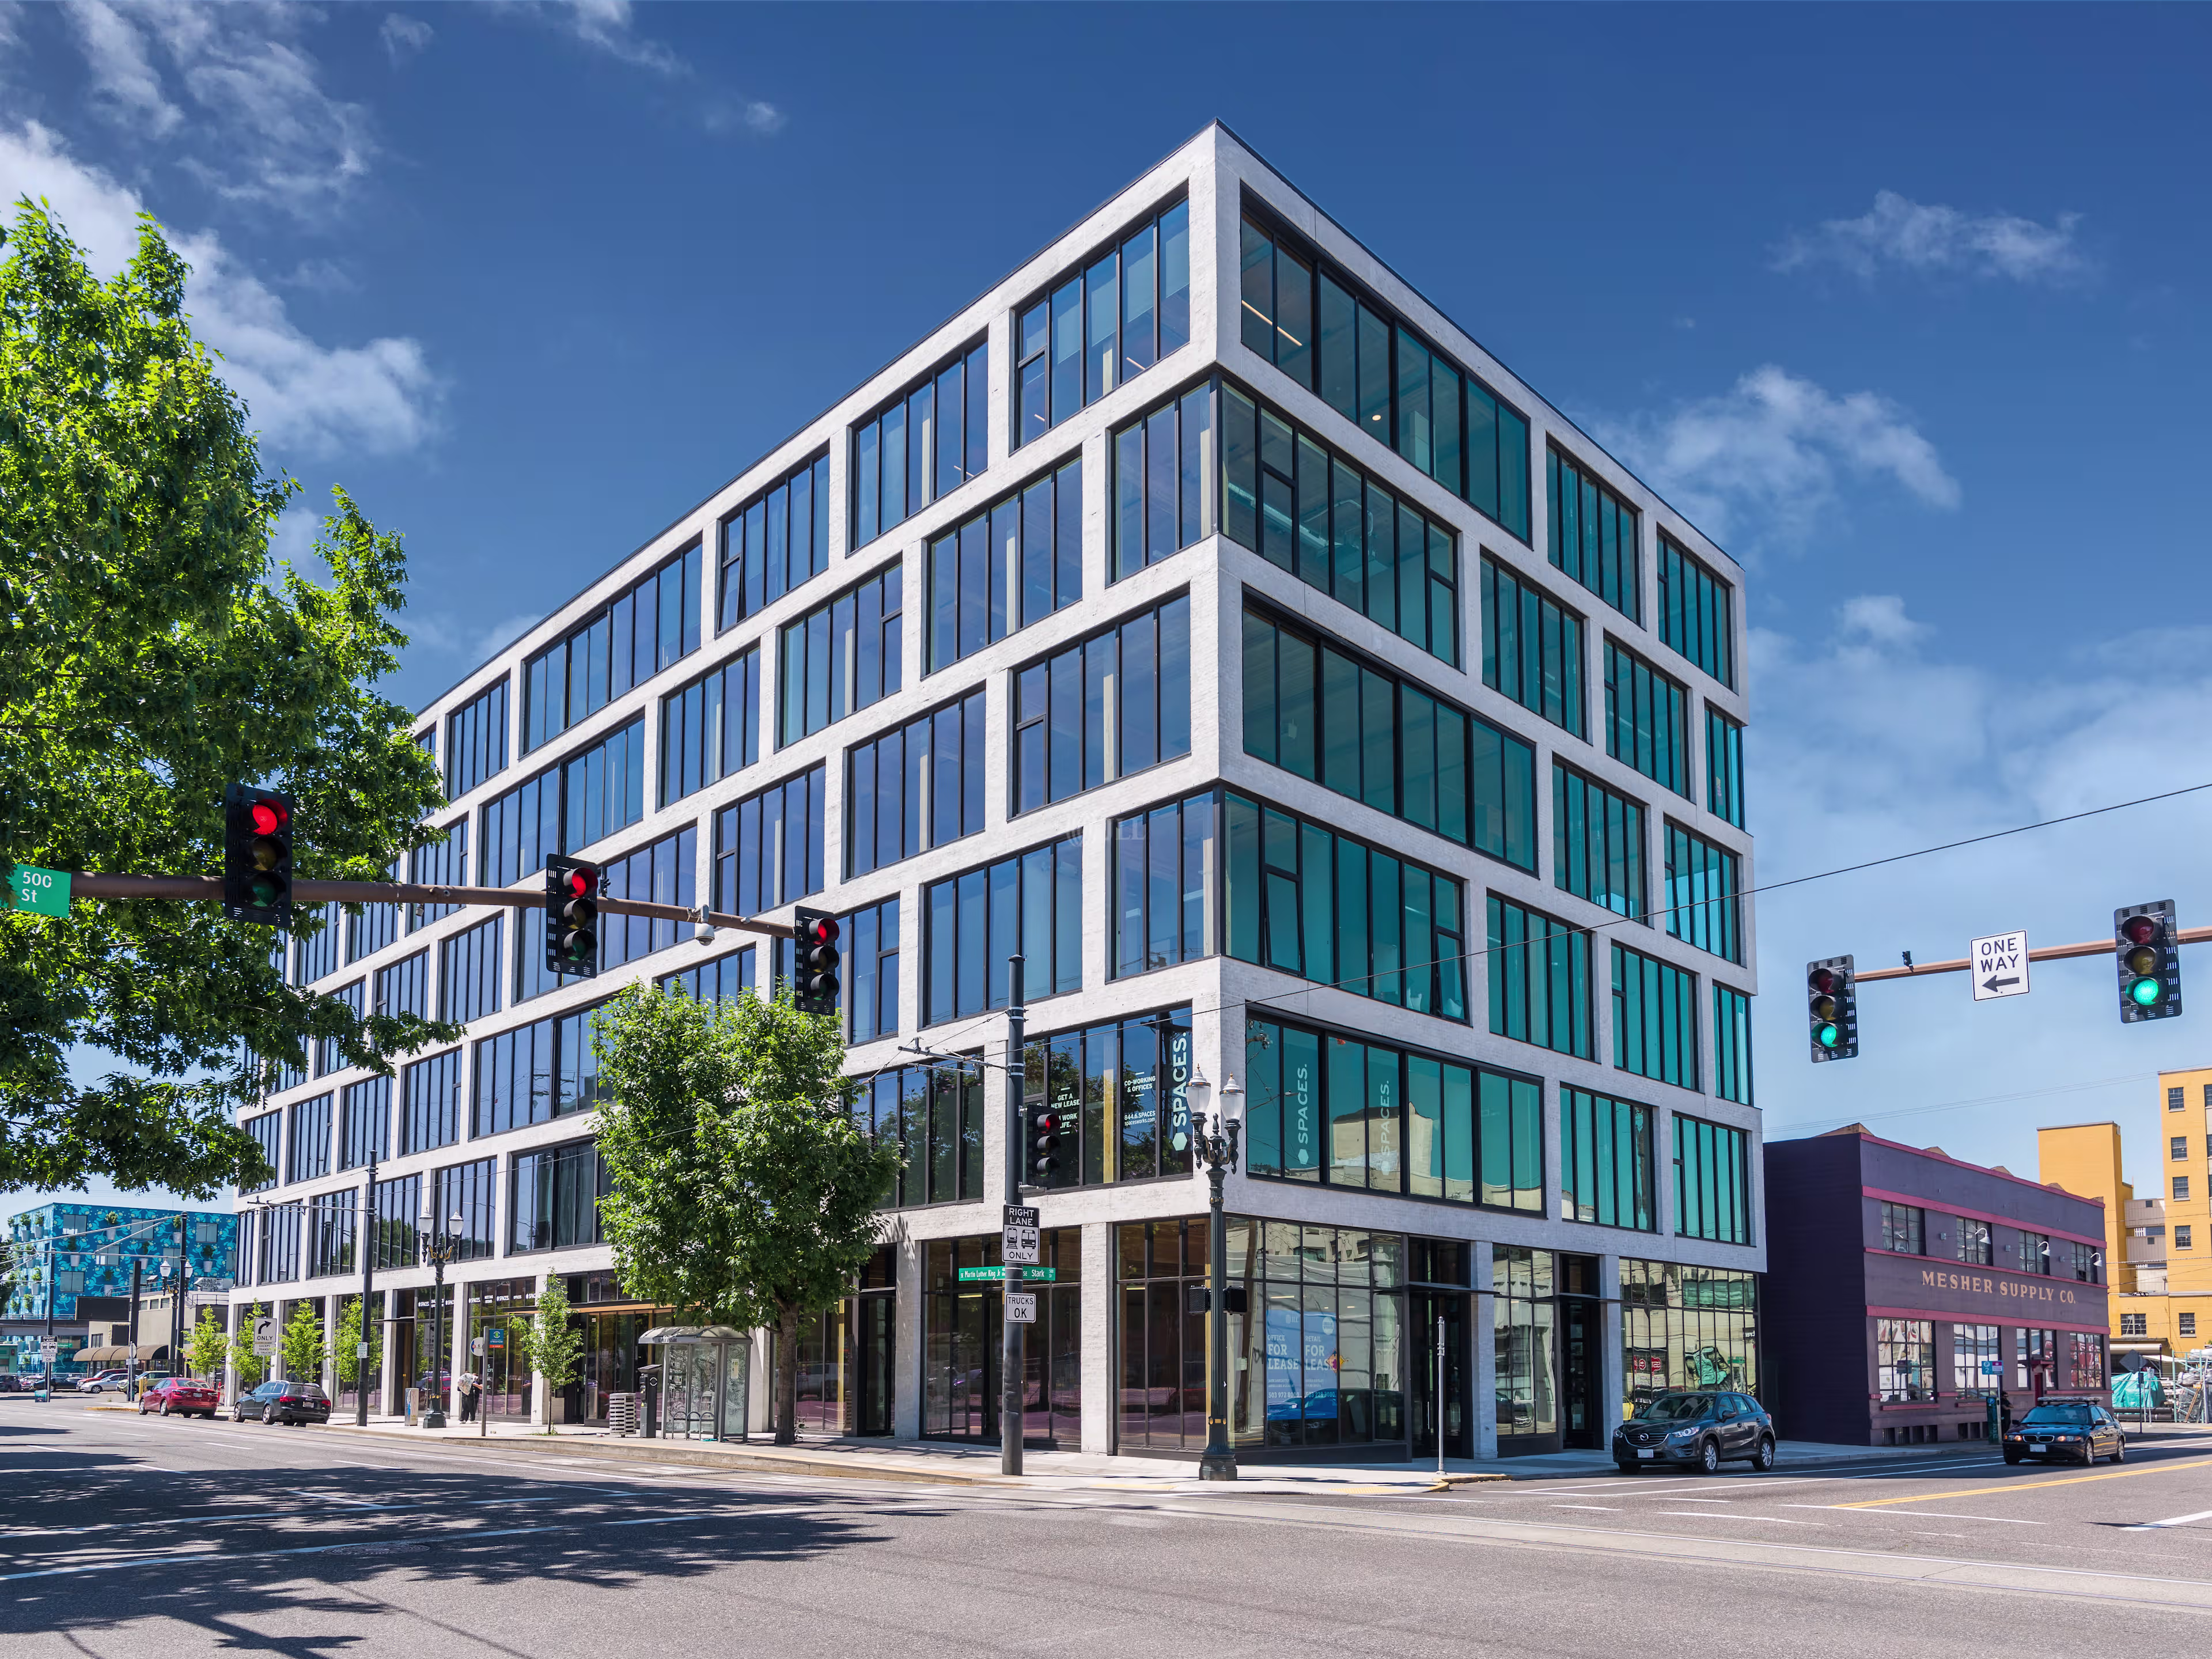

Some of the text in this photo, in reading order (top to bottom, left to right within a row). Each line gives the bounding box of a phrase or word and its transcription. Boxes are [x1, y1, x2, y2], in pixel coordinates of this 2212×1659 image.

[23, 871, 52, 888] 500
[21, 888, 37, 903] St
[1981, 937, 2017, 956] ONE
[1980, 954, 2019, 972] WAY
[1124, 1075, 1156, 1086] CO-WORKING
[1172, 1032, 1187, 1127] SPACES.
[1132, 1083, 1153, 1092] OFFICES
[1063, 1099, 1080, 1107] LEASE
[1297, 1063, 1308, 1145] SPACES.
[1062, 1113, 1077, 1121] WORK
[1124, 1111, 1156, 1120] 844.6.SPACES
[1380, 1080, 1390, 1157] SPACES.
[1124, 1117, 1156, 1126] spacesworks.com
[1009, 1207, 1034, 1217] RIGHT
[1009, 1217, 1033, 1226] LANE
[1009, 1251, 1033, 1260] ONLY
[1032, 1269, 1044, 1277] Stark
[1922, 1271, 2076, 1304] MESHER SUPPLY CO.
[1008, 1297, 1033, 1305] TRUCKS
[1267, 1343, 1287, 1355] FOR
[1305, 1344, 1325, 1357] FOR
[1267, 1358, 1299, 1370] LEASE
[1305, 1359, 1335, 1370] LEAS
